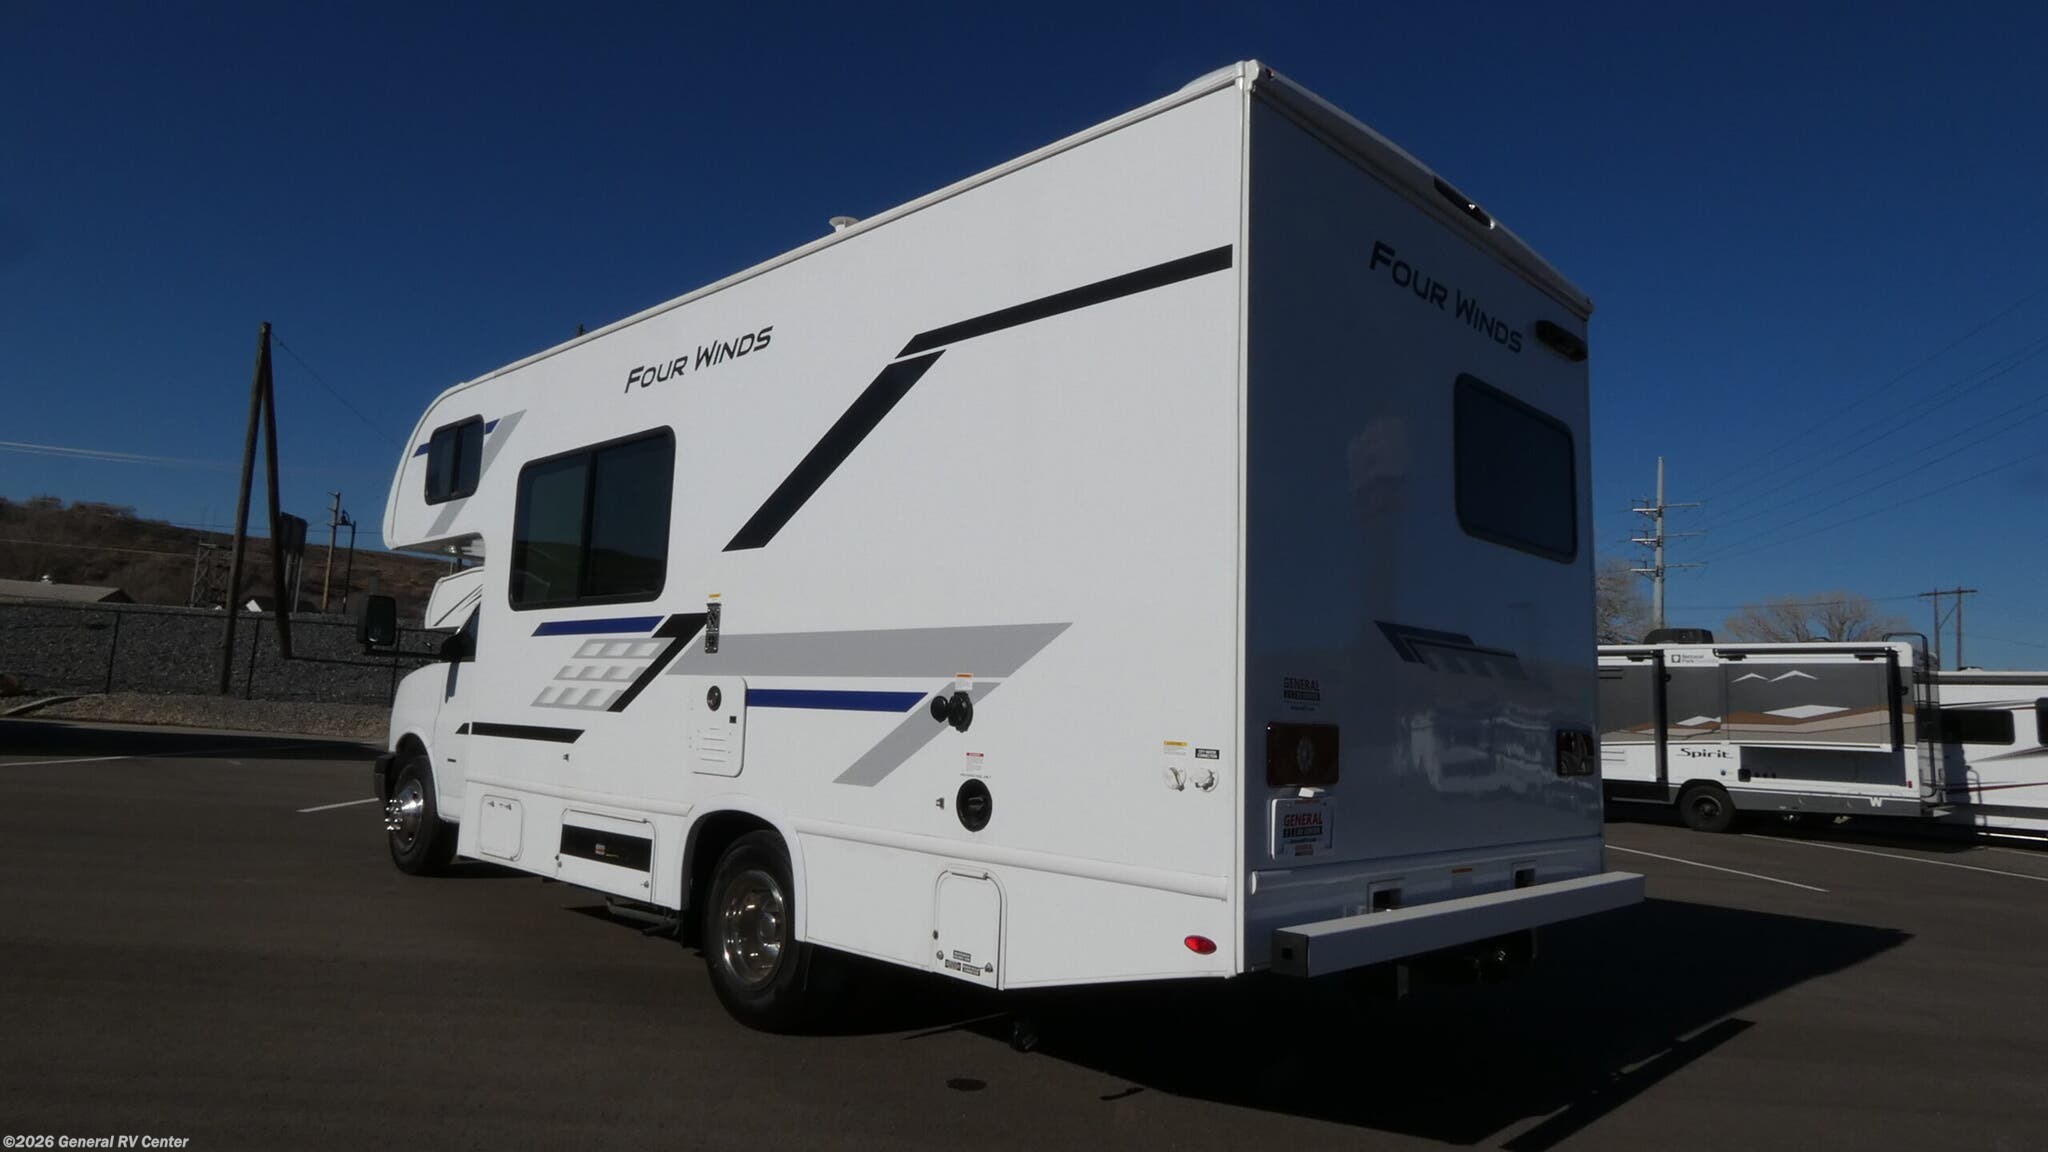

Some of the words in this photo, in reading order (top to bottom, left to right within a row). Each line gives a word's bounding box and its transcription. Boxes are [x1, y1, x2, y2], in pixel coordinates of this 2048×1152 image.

[1283, 677, 1320, 691] GENERAL
[1675, 747, 1734, 759] Spirit
[1283, 812, 1323, 827] GENERAL
